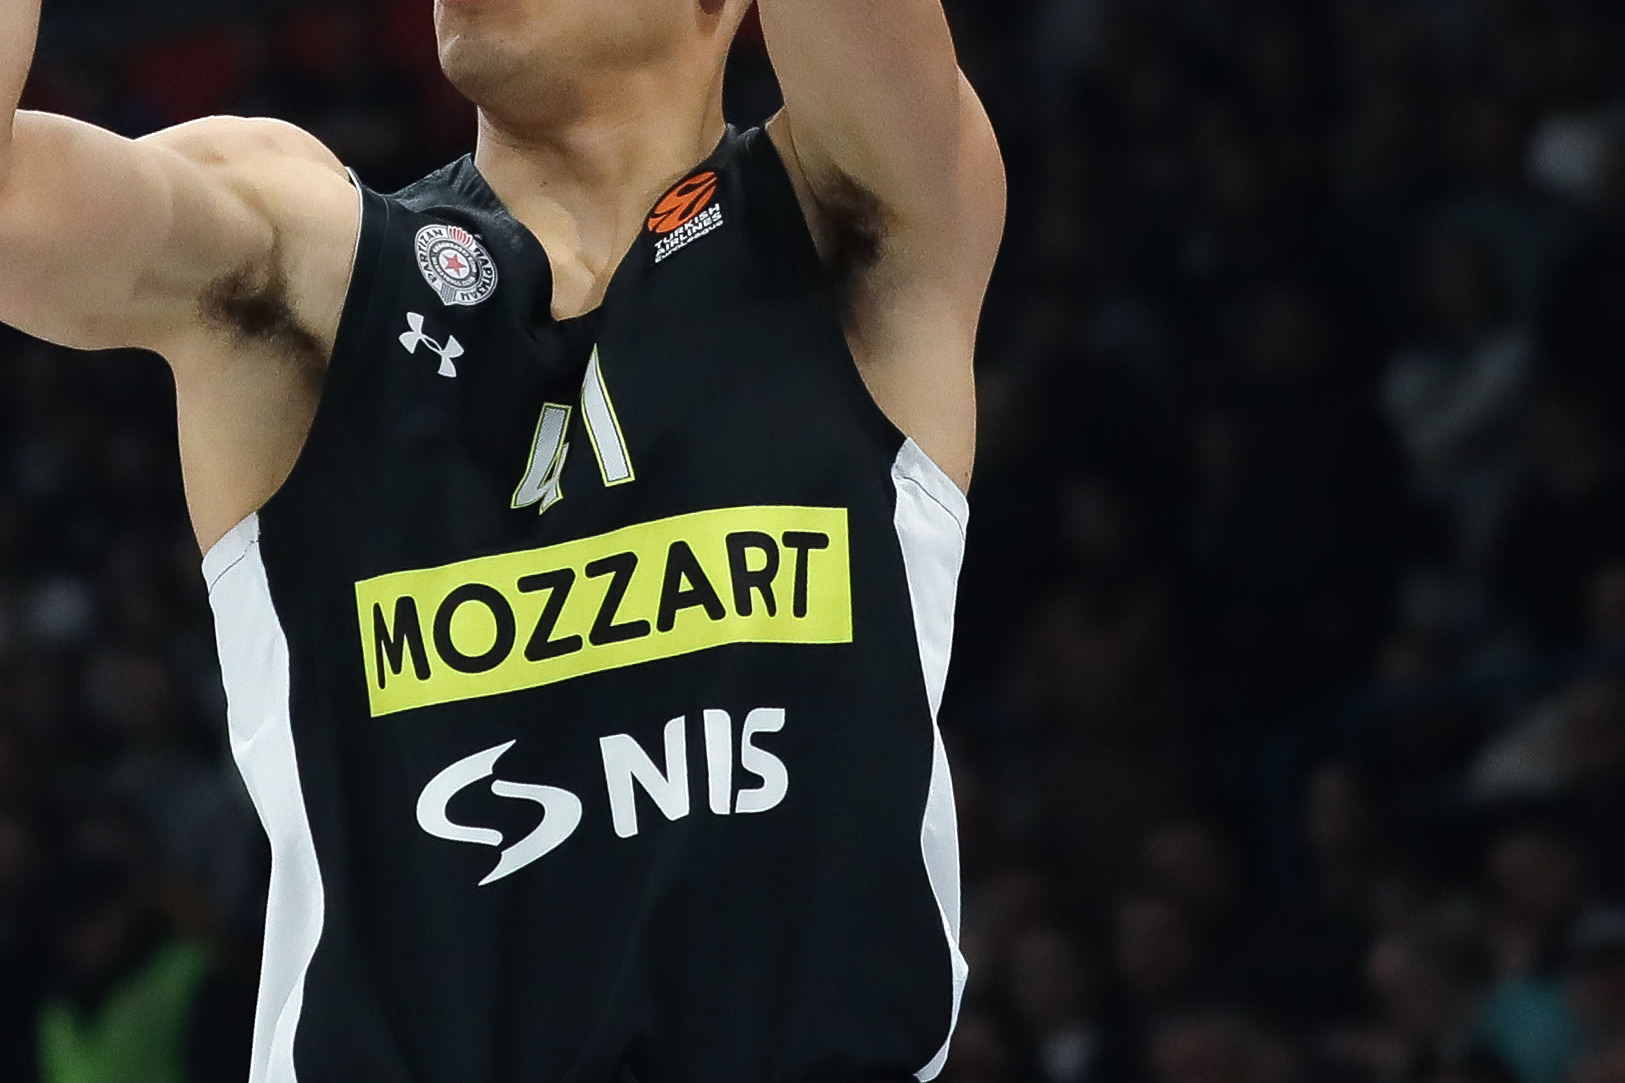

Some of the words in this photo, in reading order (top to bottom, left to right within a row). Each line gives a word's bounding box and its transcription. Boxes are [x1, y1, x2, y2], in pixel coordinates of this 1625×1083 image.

[654, 203, 720, 248] TURKISH
[656, 211, 722, 257] AIRLINES
[417, 228, 443, 283] PARTIZAN
[373, 530, 829, 690] MOZZART
[599, 707, 789, 838] NIS
